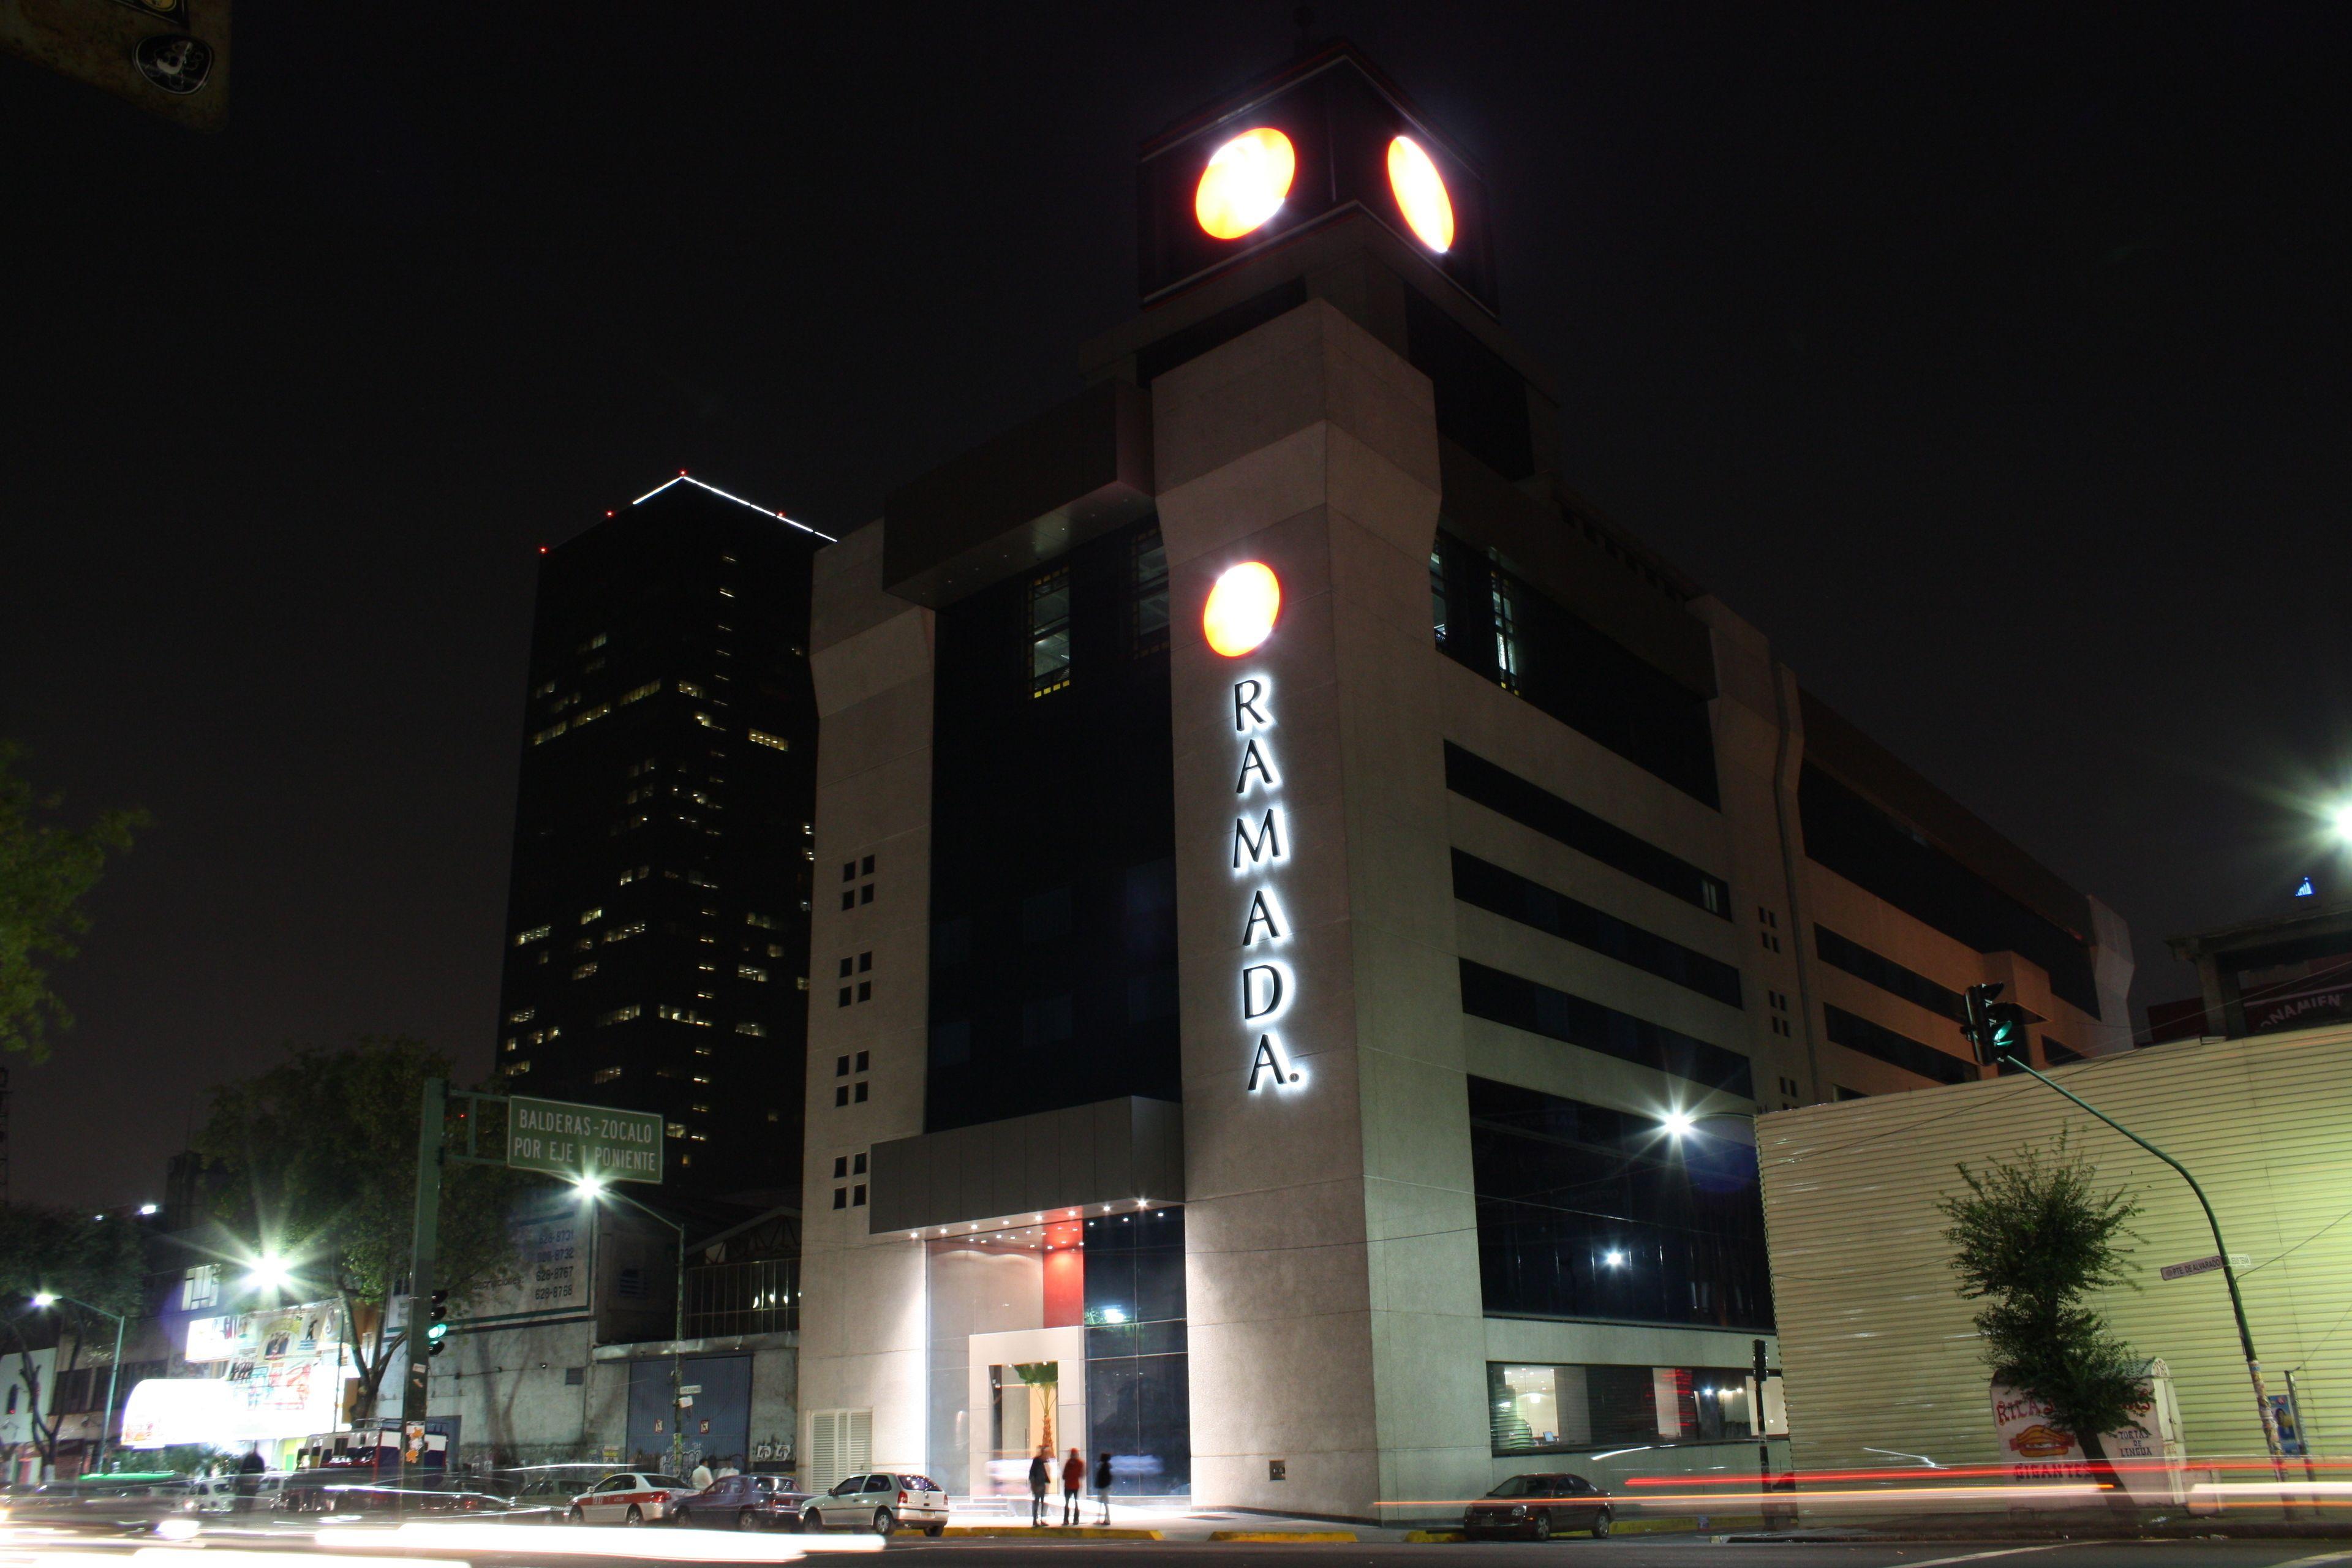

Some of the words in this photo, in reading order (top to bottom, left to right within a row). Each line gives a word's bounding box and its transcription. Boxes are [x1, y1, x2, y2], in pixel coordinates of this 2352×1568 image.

[1233, 679, 1287, 1091] RAMADA
[519, 1109, 652, 1144] BALDERAS-ZOCALO
[514, 1137, 540, 1159] POR
[549, 1141, 573, 1163] EJE
[595, 1147, 655, 1171] PONIENTE
[536, 1265, 573, 1281] 628-8767
[2193, 1259, 2220, 1271] ALVARADO
